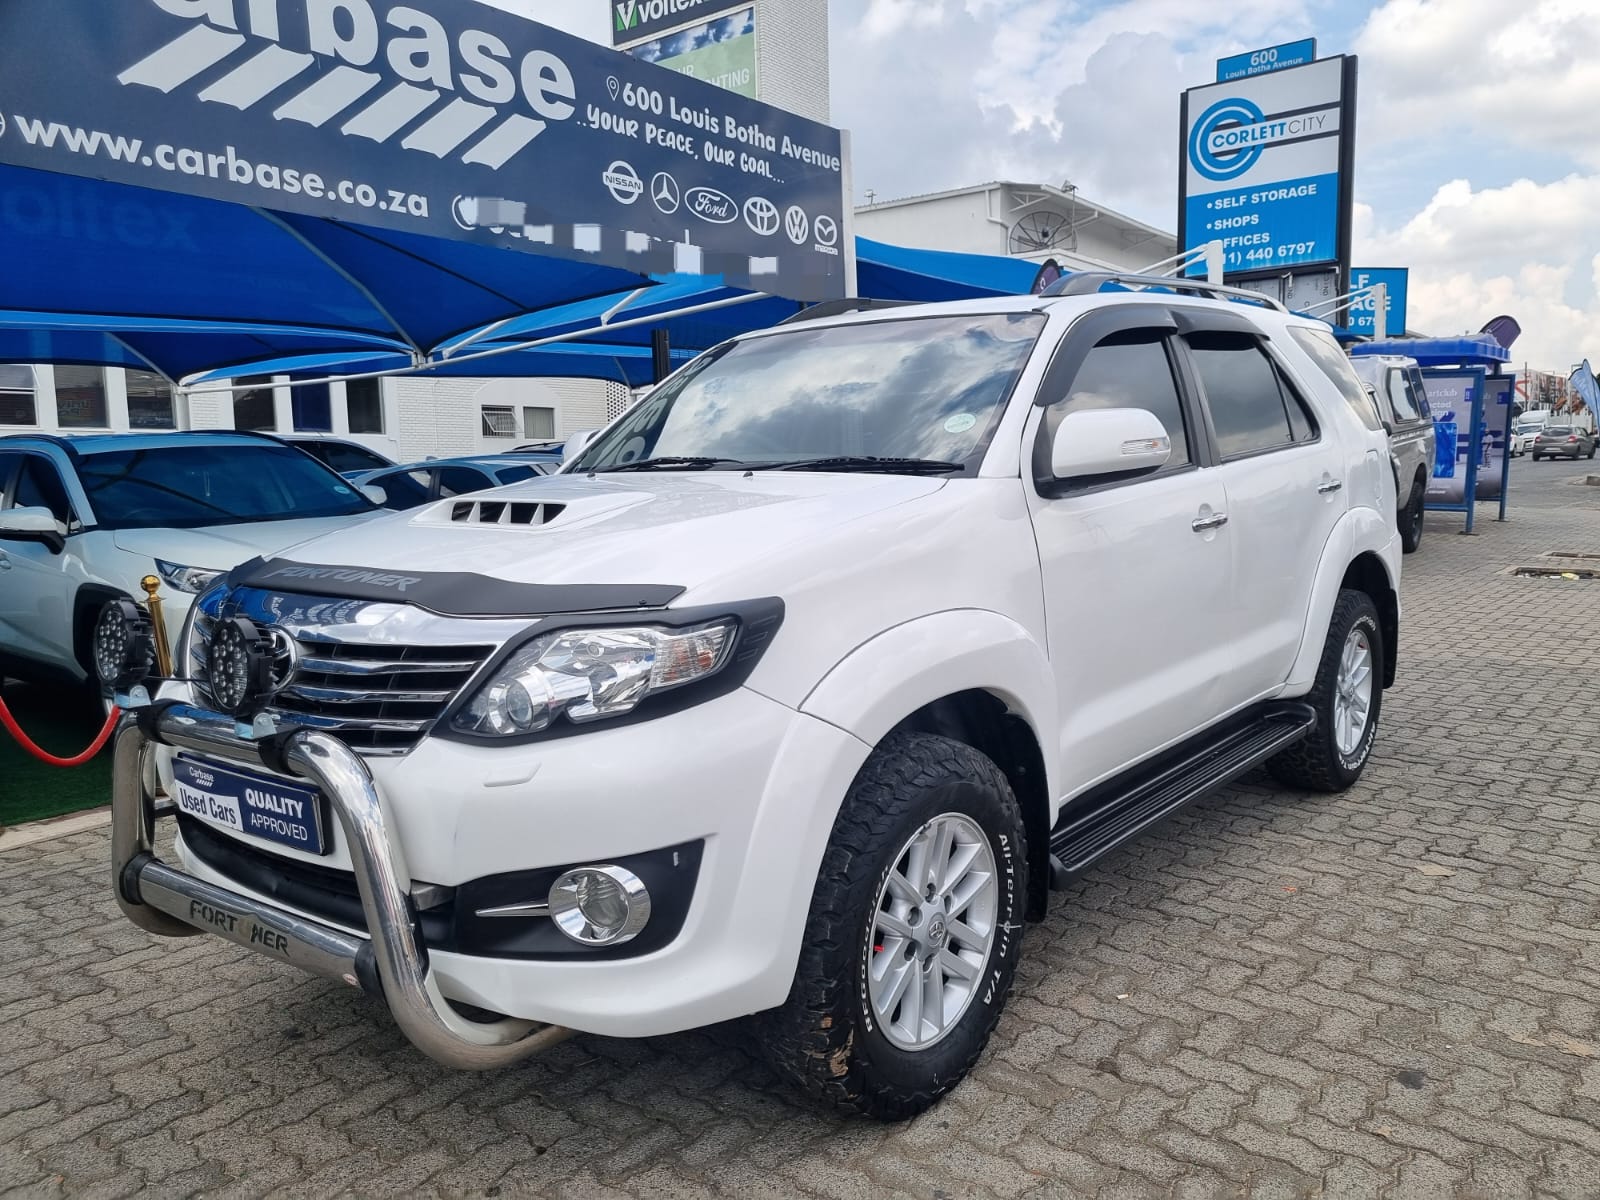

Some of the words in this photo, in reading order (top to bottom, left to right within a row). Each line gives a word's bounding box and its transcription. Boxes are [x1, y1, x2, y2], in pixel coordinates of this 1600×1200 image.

[1225, 68, 1246, 79] Louis
[1247, 64, 1271, 75] Botha
[1272, 57, 1304, 69] Avenue
[1250, 48, 1278, 66] 600
[622, 82, 664, 116] 600
[669, 96, 720, 135] Louis
[724, 115, 777, 153] Botha
[780, 135, 841, 173] Avenue
[645, 121, 699, 160] PEACE,
[703, 140, 735, 168] OUR
[14, 114, 430, 219] www.carbase.co.za
[604, 174, 642, 192] NISSAN
[1214, 195, 1247, 210] SELF
[1251, 183, 1318, 204] STORAGE
[694, 191, 729, 218] Ford
[1213, 214, 1260, 230] SHOPS
[1221, 232, 1271, 249] FFICES
[1246, 247, 1273, 261] 440
[1277, 241, 1316, 257] 6797
[263, 566, 422, 592] FORTUNER
[179, 787, 208, 815] Used
[209, 797, 237, 825] Cars
[245, 787, 304, 819] QUALITY
[251, 812, 308, 841] APPROVED
[983, 969, 1002, 1005] T/A
